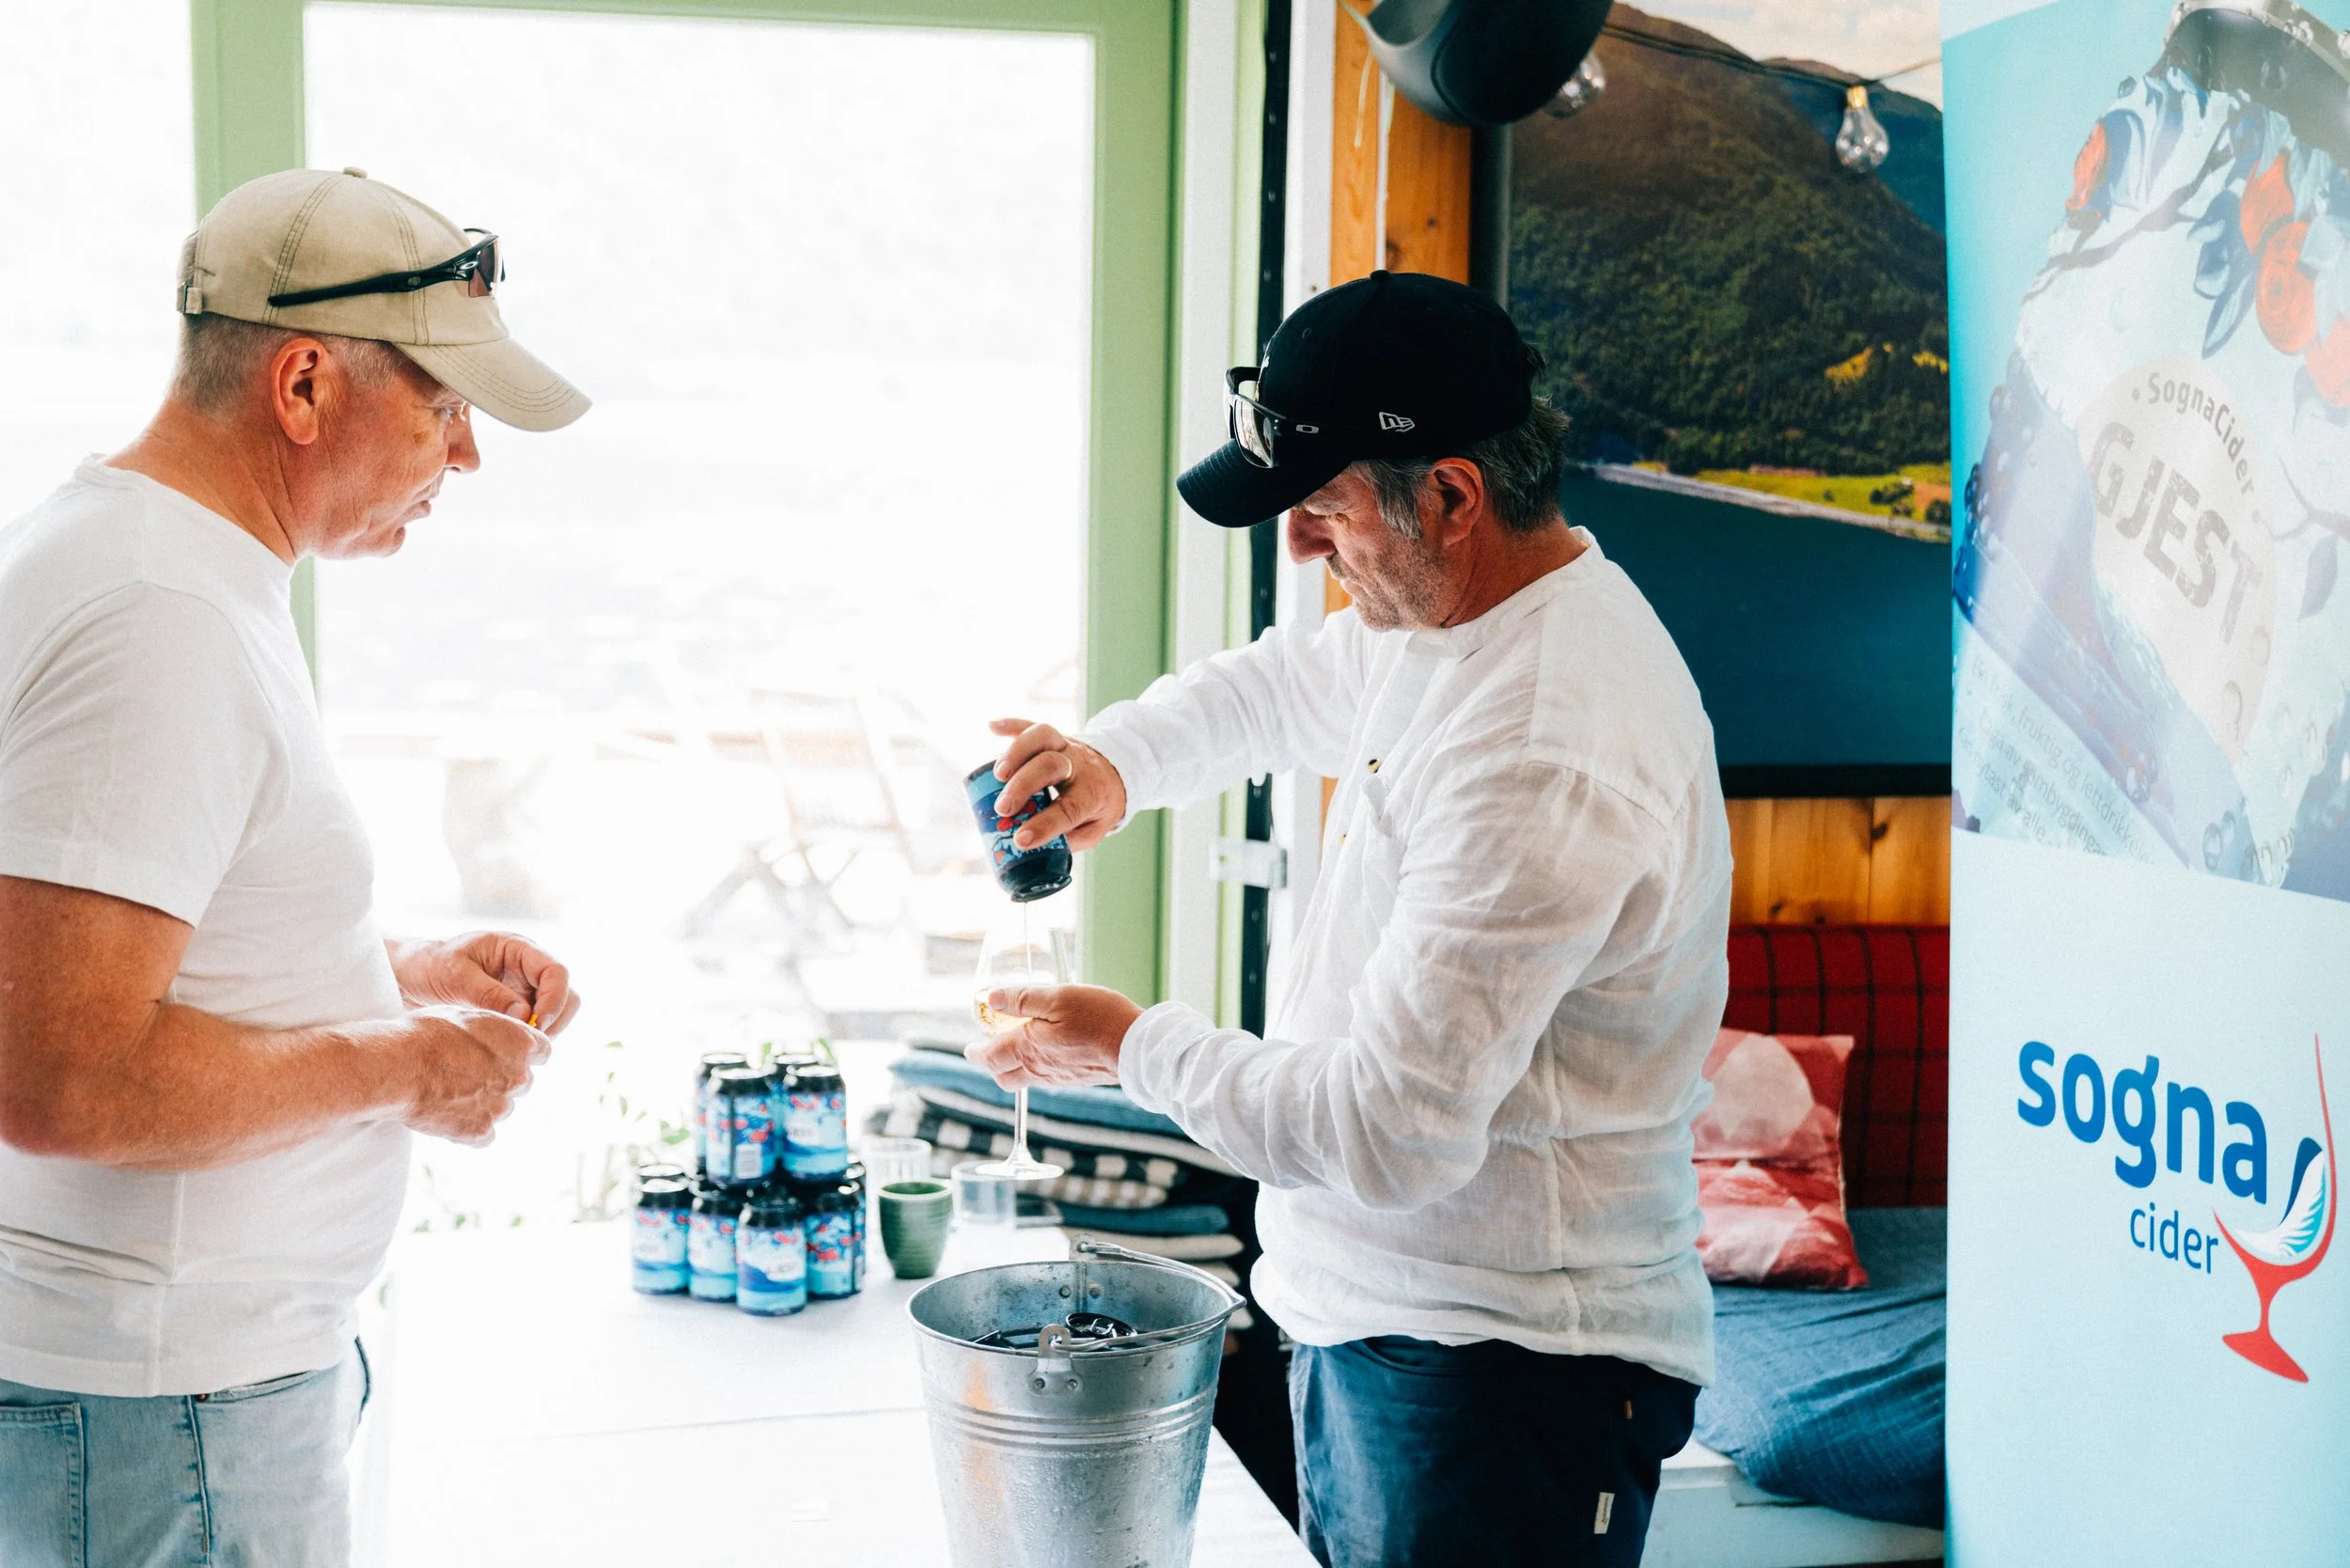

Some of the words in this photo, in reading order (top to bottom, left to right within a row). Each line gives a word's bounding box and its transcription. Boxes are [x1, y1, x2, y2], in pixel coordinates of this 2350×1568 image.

[2147, 372, 2254, 496] SognaCider
[2089, 420, 2264, 646] GJEST
[2018, 706, 2063, 769] fruktig
[2062, 758, 2081, 790] og
[2080, 771, 2154, 864] lettdrikkele
[2016, 1040, 2268, 1204] sogna
[2129, 1201, 2219, 1275] cider
